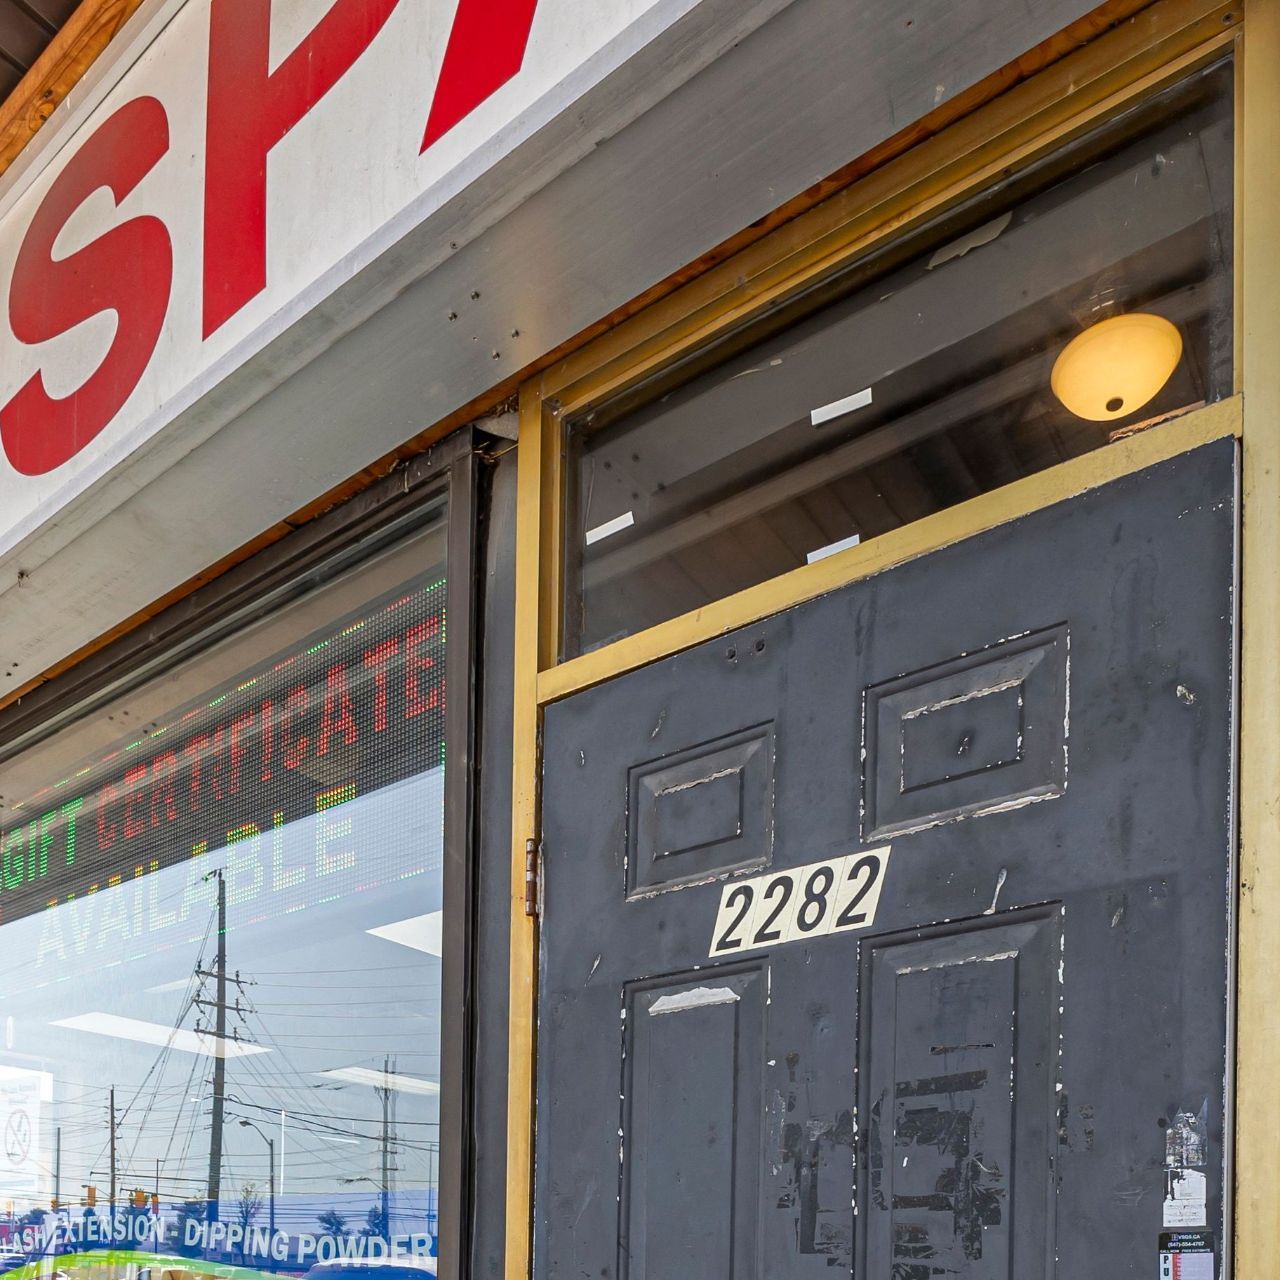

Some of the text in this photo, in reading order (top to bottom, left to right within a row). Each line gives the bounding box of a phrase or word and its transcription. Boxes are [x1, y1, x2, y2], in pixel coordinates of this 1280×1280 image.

[0, 615, 440, 895] GIFT CERTIFICATE
[35, 782, 357, 969] AVAILABLE
[715, 854, 881, 952] 2282
[54, 1213, 165, 1245] EXTENSION
[183, 1218, 290, 1262] DIPPING
[297, 1232, 434, 1268] POWDER
